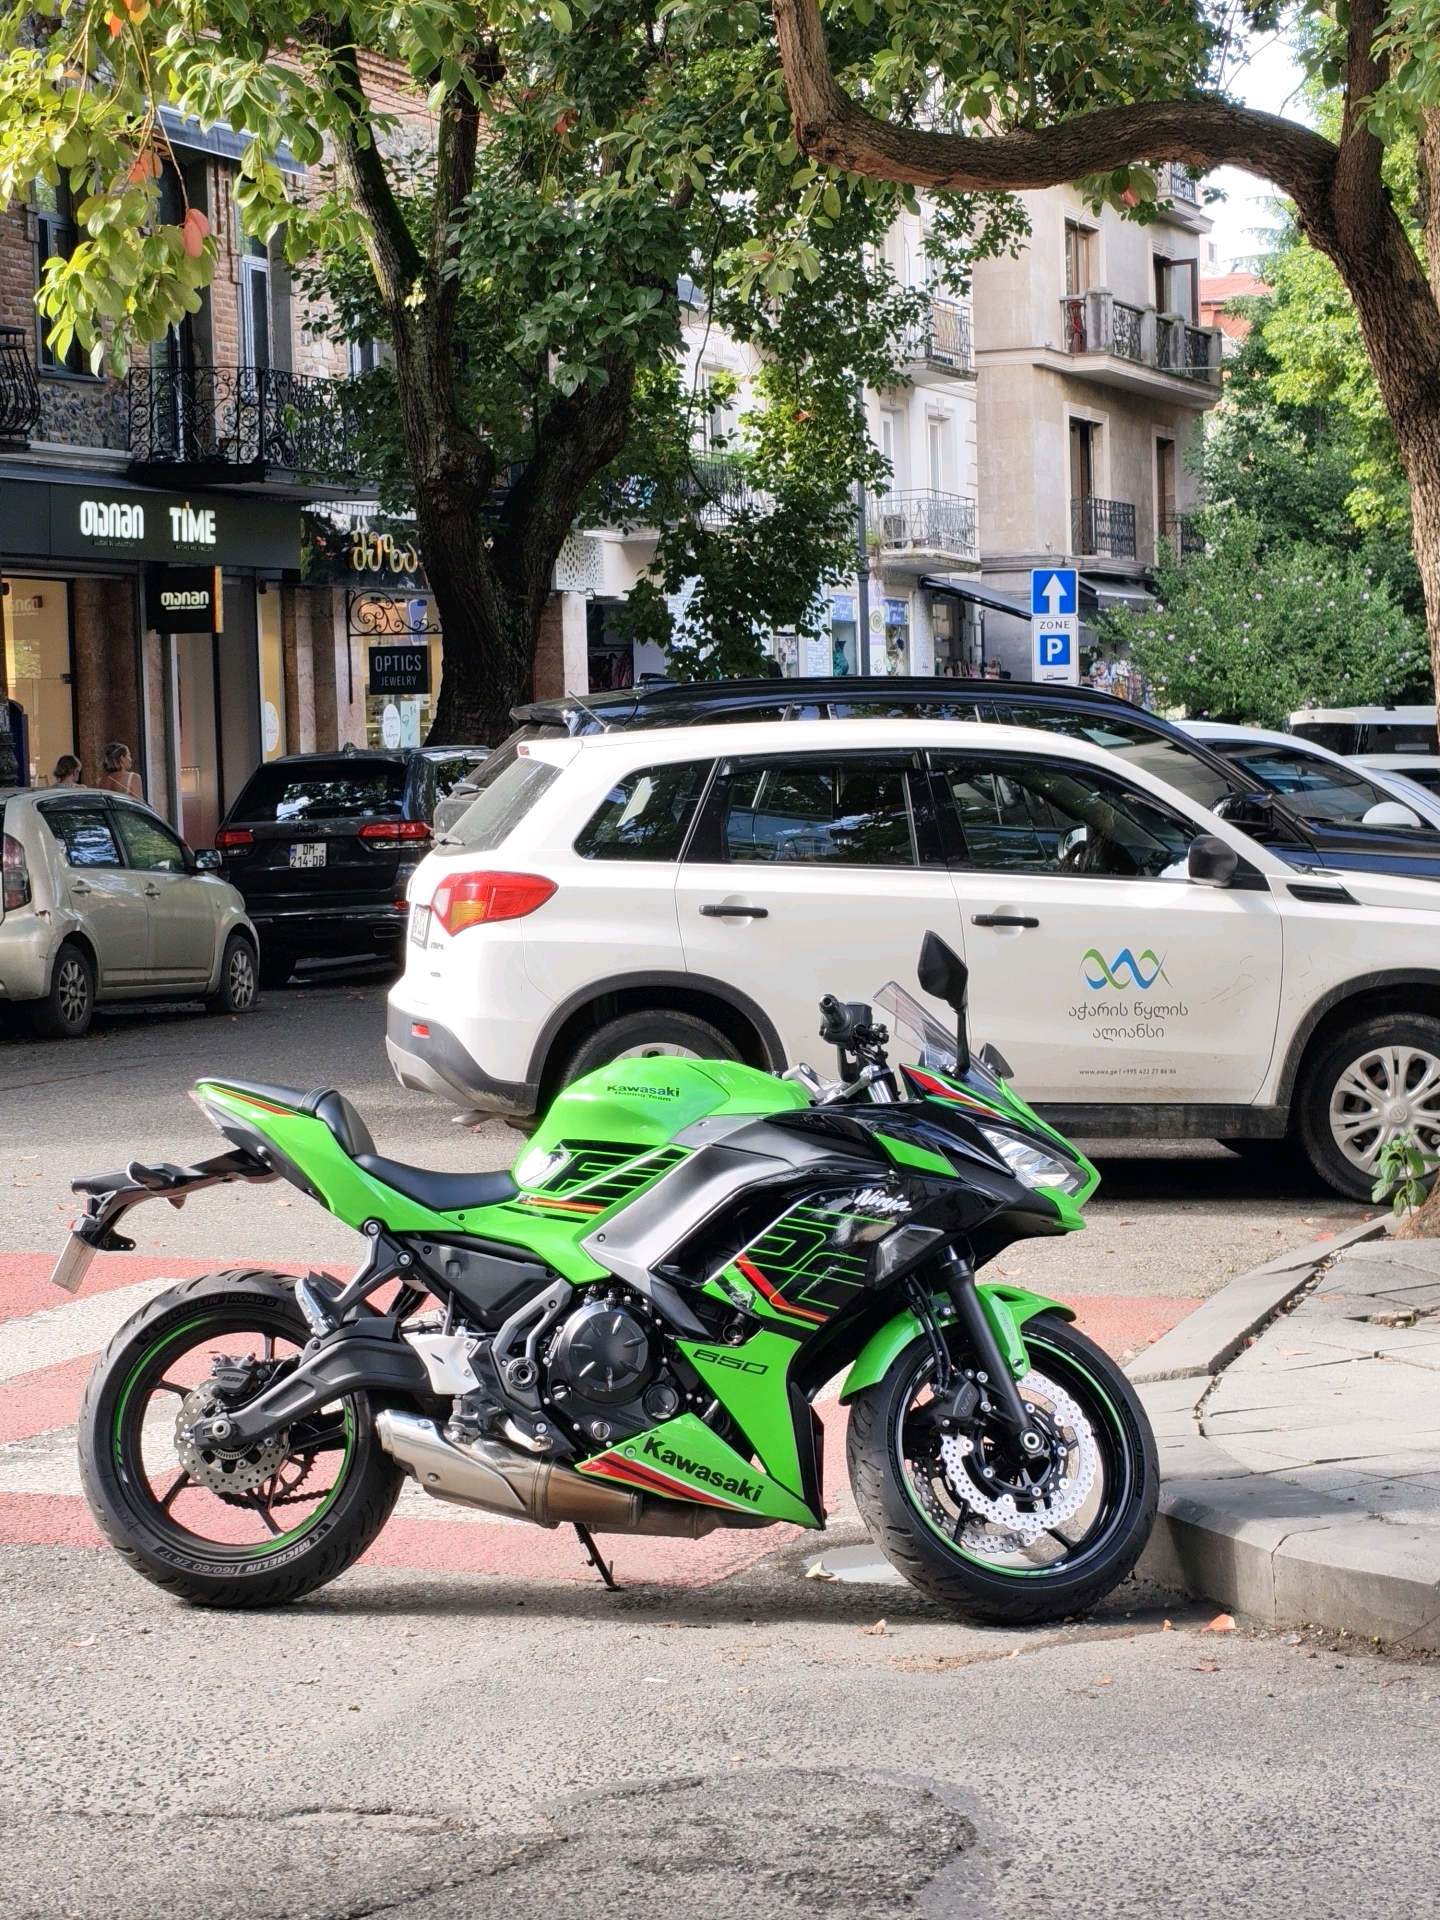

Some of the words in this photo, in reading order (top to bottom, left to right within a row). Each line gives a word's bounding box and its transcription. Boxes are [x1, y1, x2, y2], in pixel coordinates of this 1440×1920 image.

[169, 503, 217, 544] TIME
[1039, 620, 1070, 630] ZONE
[1047, 638, 1063, 662] P
[374, 654, 422, 672] OPTICS
[381, 675, 417, 686] JEWELRY
[290, 855, 325, 868] 214-DB
[1068, 1001, 1129, 1020] აჭარის
[1133, 1001, 1189, 1020] წყლის
[1092, 1023, 1165, 1042] ალიანსი
[606, 1084, 680, 1098] Kawasaki
[647, 1094, 672, 1102] Team
[853, 1188, 913, 1213] Ninja
[157, 1295, 220, 1328] MICHELIN
[231, 1292, 264, 1305] ROAD
[266, 1297, 275, 1306] 6
[692, 1348, 770, 1376] 650
[643, 1436, 765, 1503] Kawasaki
[158, 1549, 172, 1560] 17
[173, 1555, 189, 1567] ZR
[244, 1538, 312, 1573] MICHELIN
[192, 1562, 236, 1576] 160/60
